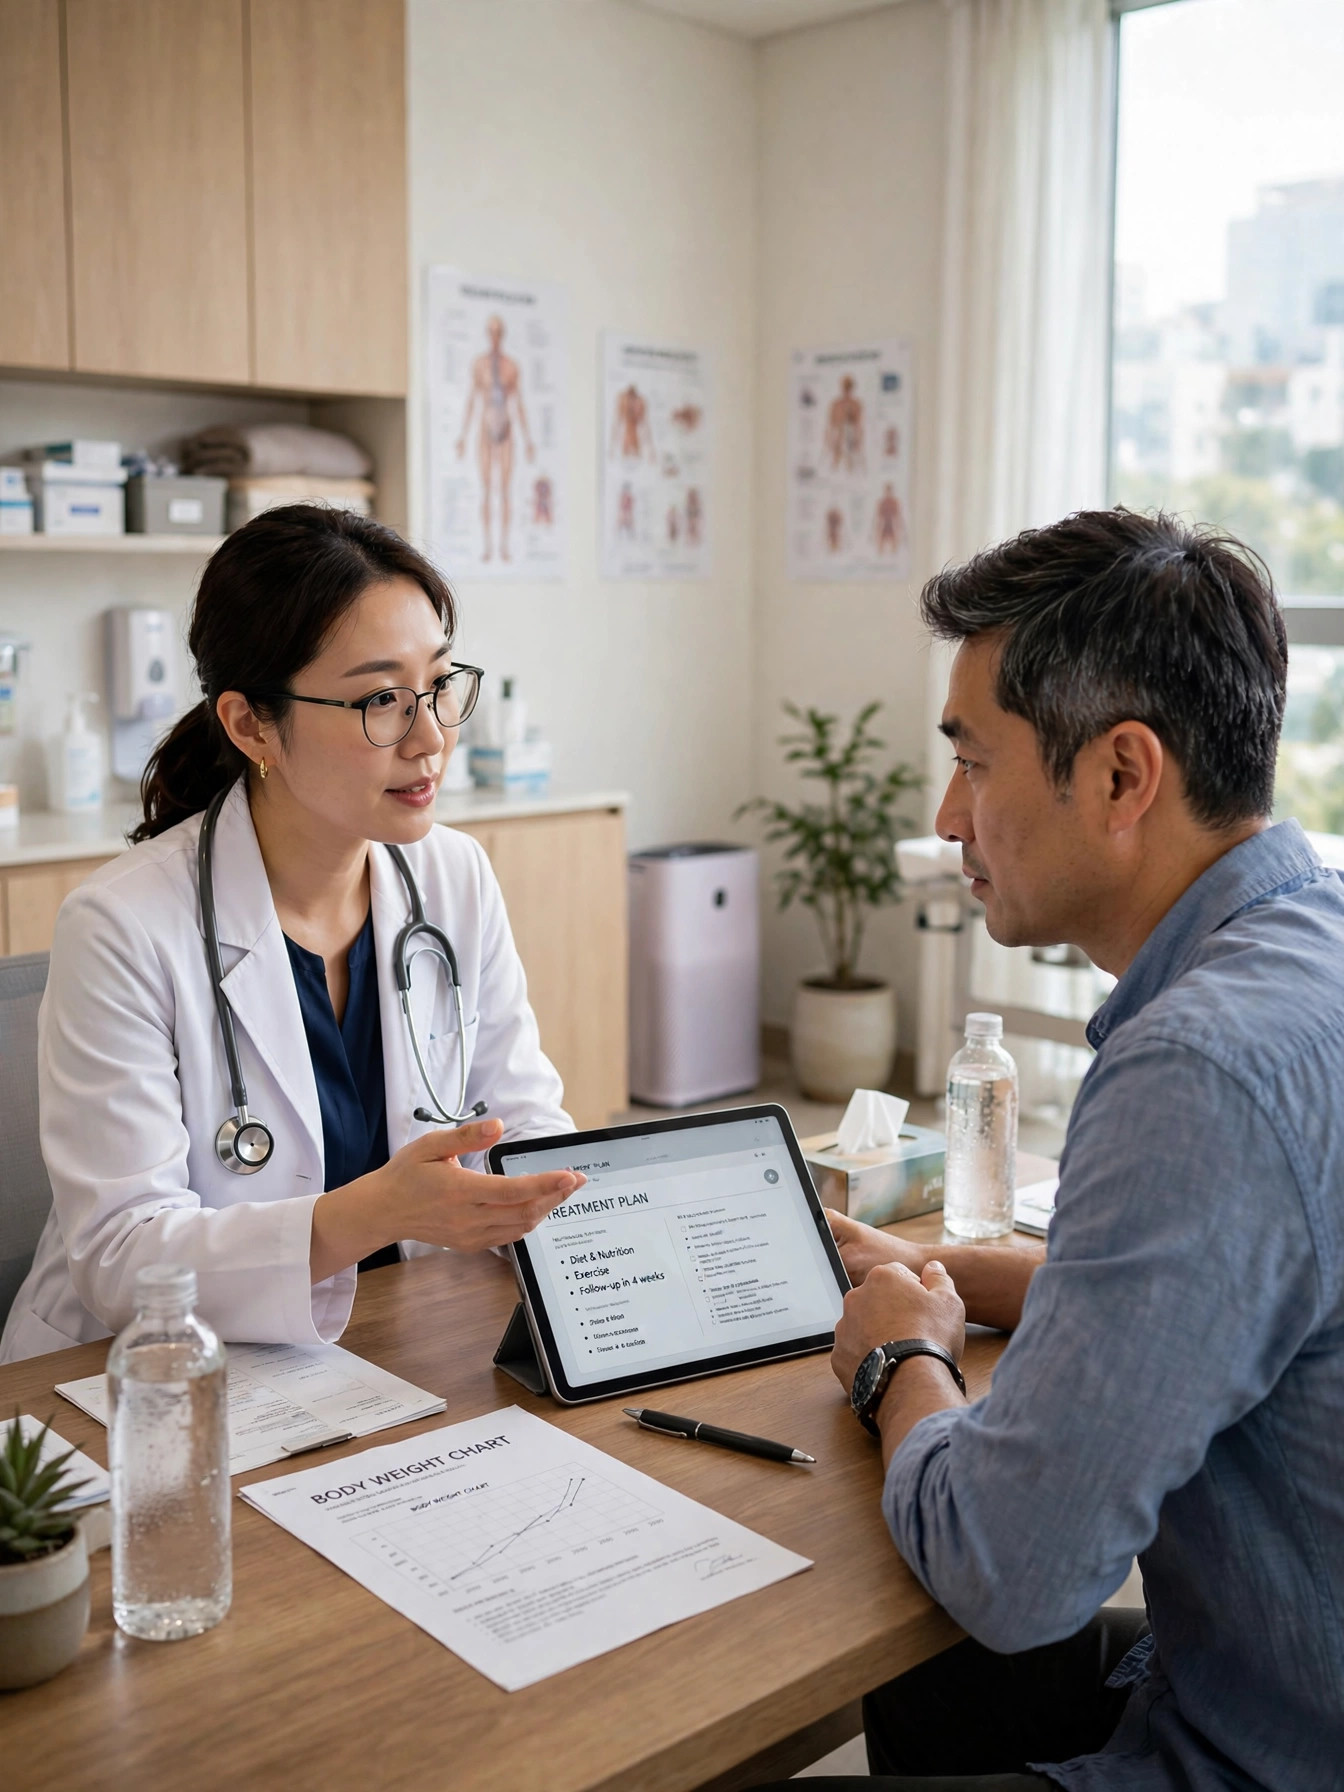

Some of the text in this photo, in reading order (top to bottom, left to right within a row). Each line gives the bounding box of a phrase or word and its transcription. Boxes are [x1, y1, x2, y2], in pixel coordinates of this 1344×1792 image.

[618, 1192, 649, 1207] PLAN
[570, 1247, 635, 1265] Diet & Nutrition
[574, 1266, 610, 1280] Exercise
[580, 1271, 665, 1295] Follow-up in 4 weeks
[310, 1481, 367, 1504] BODY
[368, 1455, 446, 1486] WEIGHT
[448, 1435, 511, 1460] CHART
